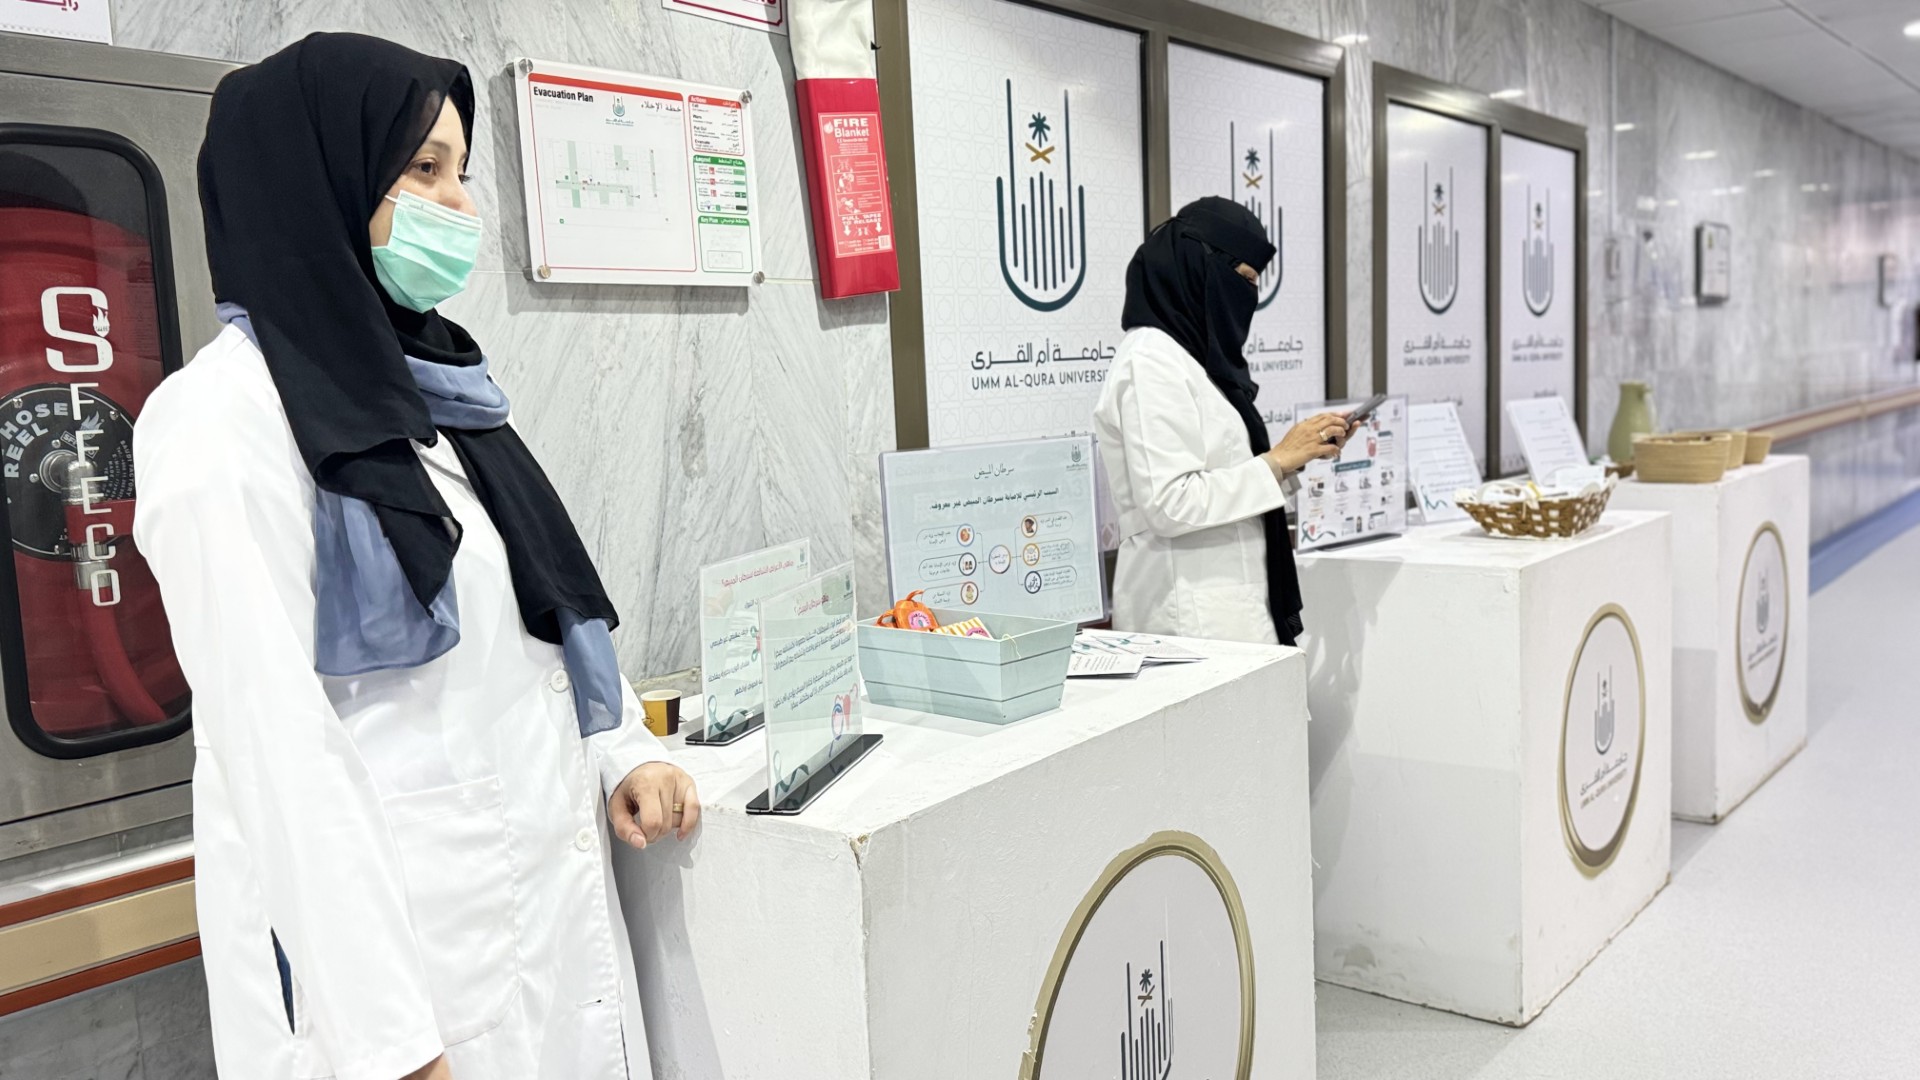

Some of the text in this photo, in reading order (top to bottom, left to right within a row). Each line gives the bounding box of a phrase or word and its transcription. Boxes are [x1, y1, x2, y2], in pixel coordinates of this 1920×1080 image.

[533, 86, 594, 103] Evacuation Plan
[665, 102, 682, 113] خطة
[833, 117, 868, 128] FIRE
[834, 127, 870, 138] Blanket
[1258, 335, 1303, 354] جامعة
[971, 342, 1033, 370] القرى
[1035, 338, 1050, 368] أم
[1263, 359, 1303, 372] UNIVERSITY
[971, 369, 1109, 390] UMM AL-QURA UNIVERSI
[0, 402, 68, 440] HOSE
[3, 422, 49, 478] REEL
[120, 439, 134, 497] SAUDI FACTORY
[974, 463, 1014, 479] سرطان المبيض
[1023, 489, 1043, 501] الرئيسي
[1043, 488, 1059, 496] السبب
[953, 501, 961, 509] غير
[963, 497, 981, 507] المبيض
[983, 496, 1004, 505] بسرطان
